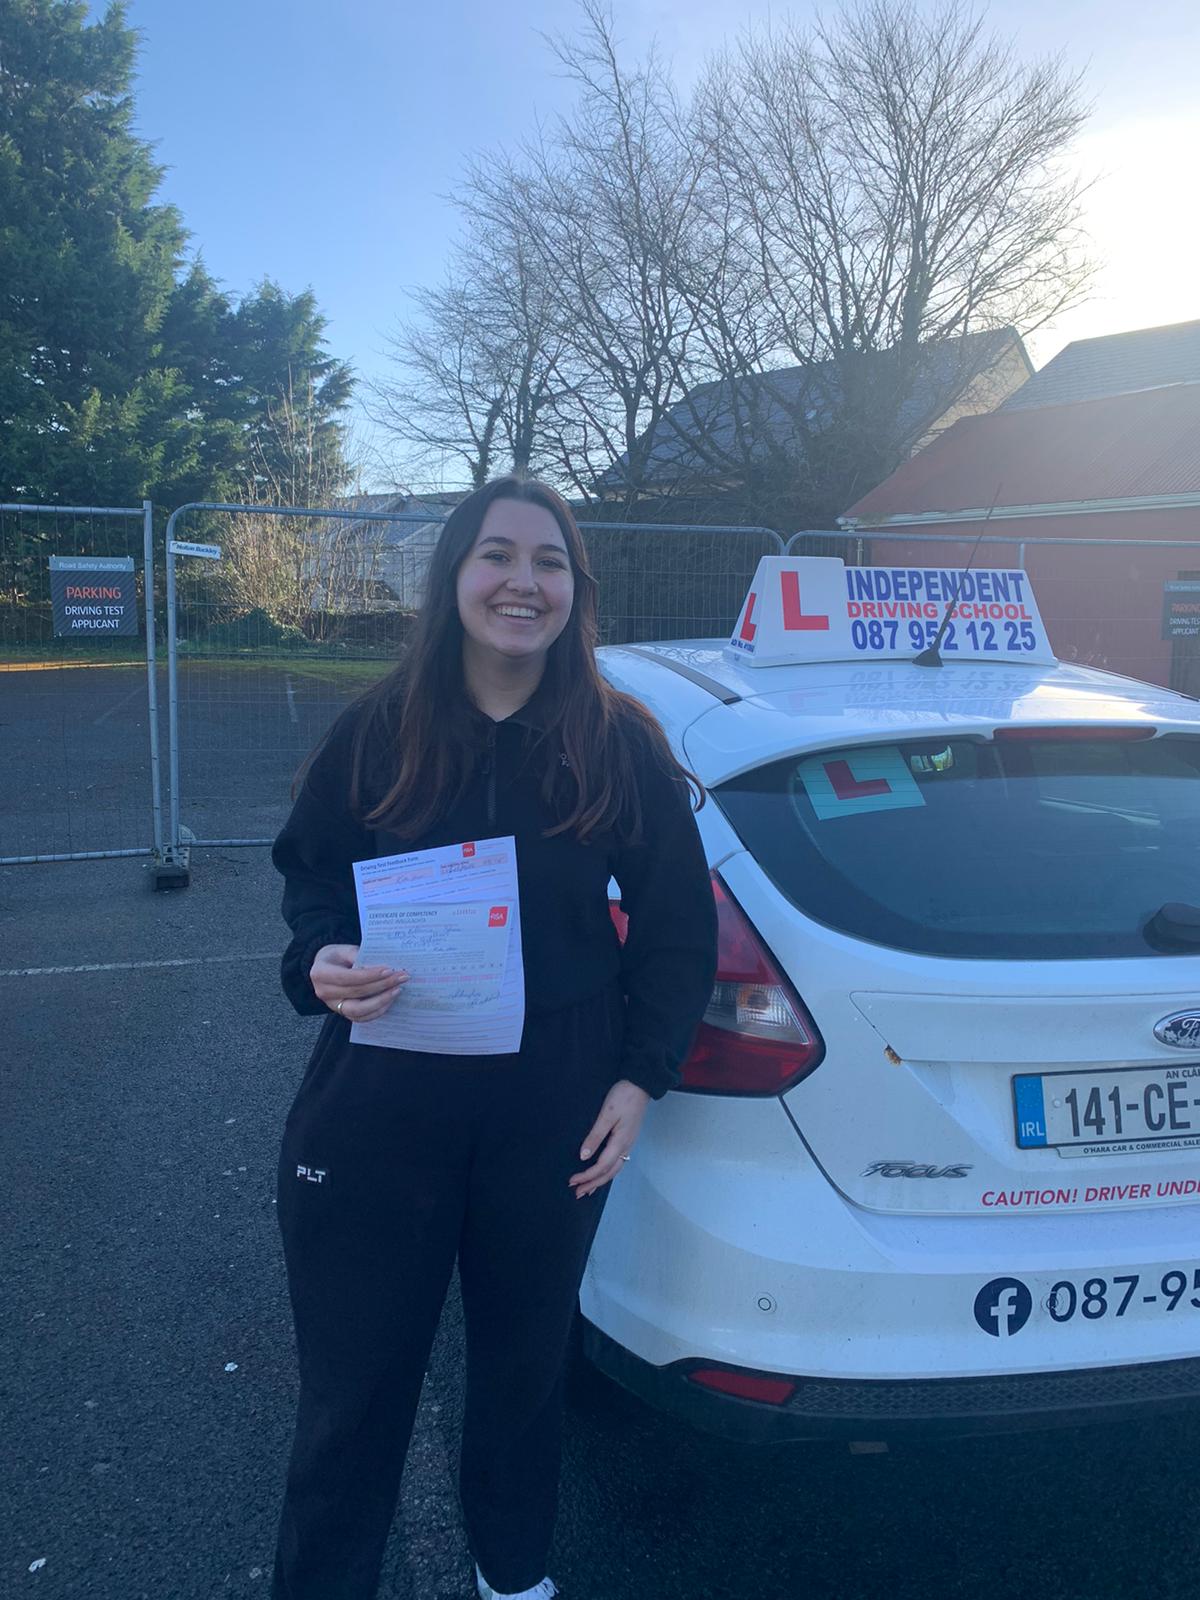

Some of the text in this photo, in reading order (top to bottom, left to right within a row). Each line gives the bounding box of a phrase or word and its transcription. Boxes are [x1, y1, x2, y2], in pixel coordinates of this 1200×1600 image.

[78, 562, 97, 570] Safety
[100, 562, 127, 570] Authority
[66, 586, 122, 599] PARKING
[846, 570, 1024, 603] INDEPENDENT
[780, 571, 830, 631] L
[65, 606, 125, 616] DRIVING TEST
[847, 601, 1033, 621] DRIVING SCHOOL
[71, 619, 120, 629] APPLICANT
[851, 620, 1037, 651] 087 952 12 25
[1166, 1071, 1180, 1079] AN
[1021, 1121, 1045, 1137] IRL
[1083, 1146, 1111, 1154] O'HARA
[1136, 1140, 1182, 1150] COMMERCIAL
[297, 1164, 326, 1184] PLT
[981, 1179, 1200, 1207] CAUTION! DRIVER UND
